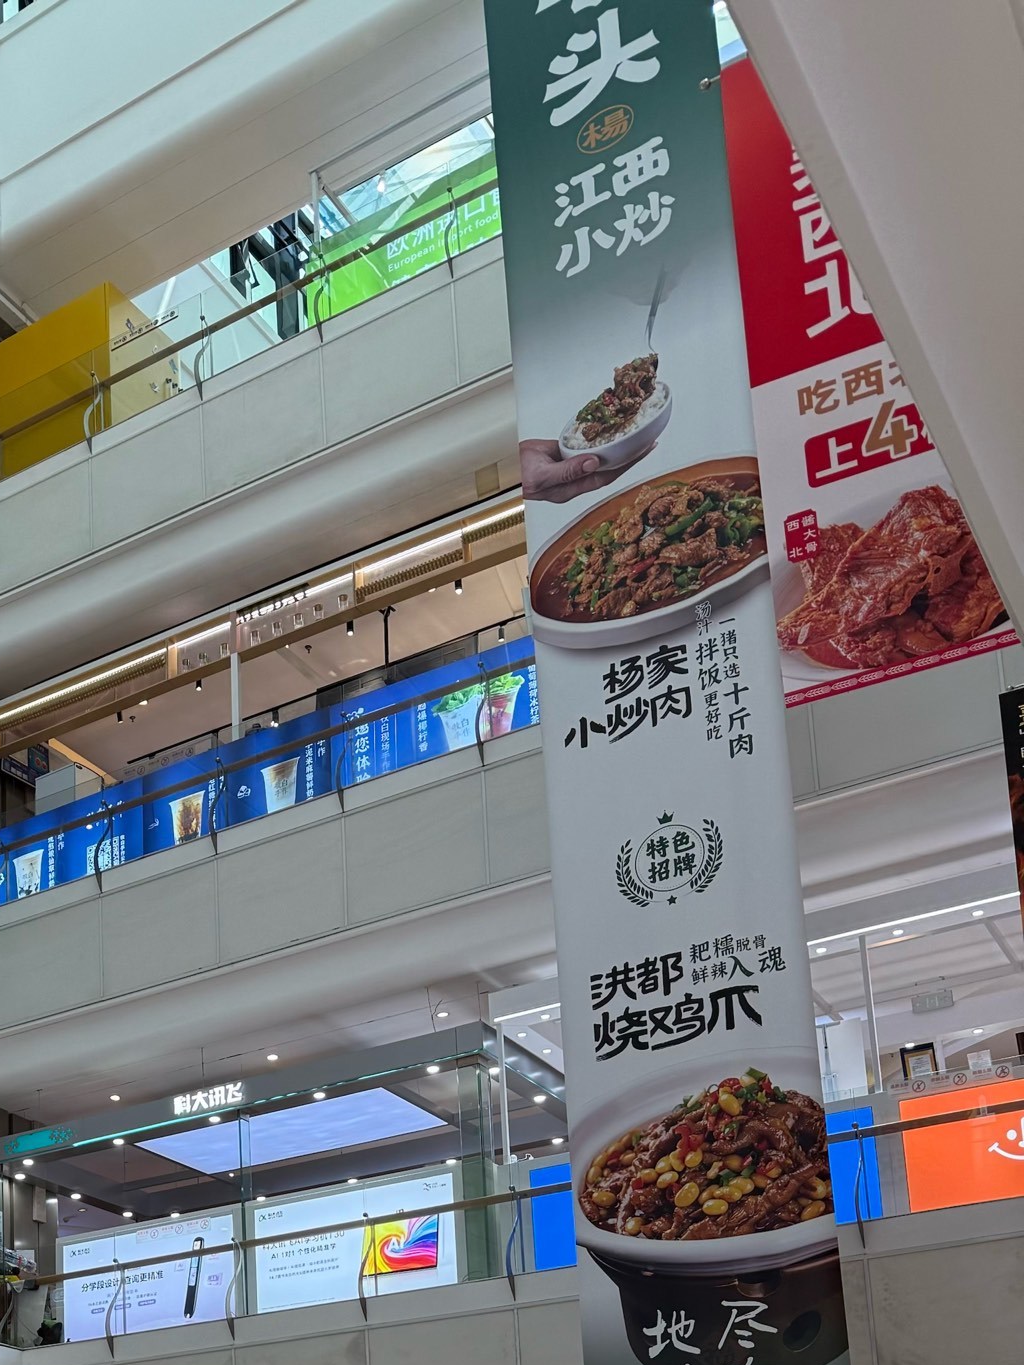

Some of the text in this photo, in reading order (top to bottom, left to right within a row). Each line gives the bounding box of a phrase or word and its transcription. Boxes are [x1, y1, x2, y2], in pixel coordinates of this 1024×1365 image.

[554, 136, 670, 228] 江西
[388, 245, 435, 273] European
[476, 211, 499, 230] food
[555, 191, 676, 278] 小炒
[815, 398, 935, 480] 上4
[602, 644, 689, 705] 杨家
[694, 600, 723, 742] 汤汁拌饭更好吃
[564, 685, 692, 749] 小炒肉
[645, 830, 696, 861] 特色
[648, 852, 698, 884] 招牌
[590, 951, 685, 1011] 洪都
[691, 946, 787, 986] 鲜辣入魂
[592, 985, 763, 1063] 烧鸡爪
[173, 1081, 243, 1115] 科大讯飞
